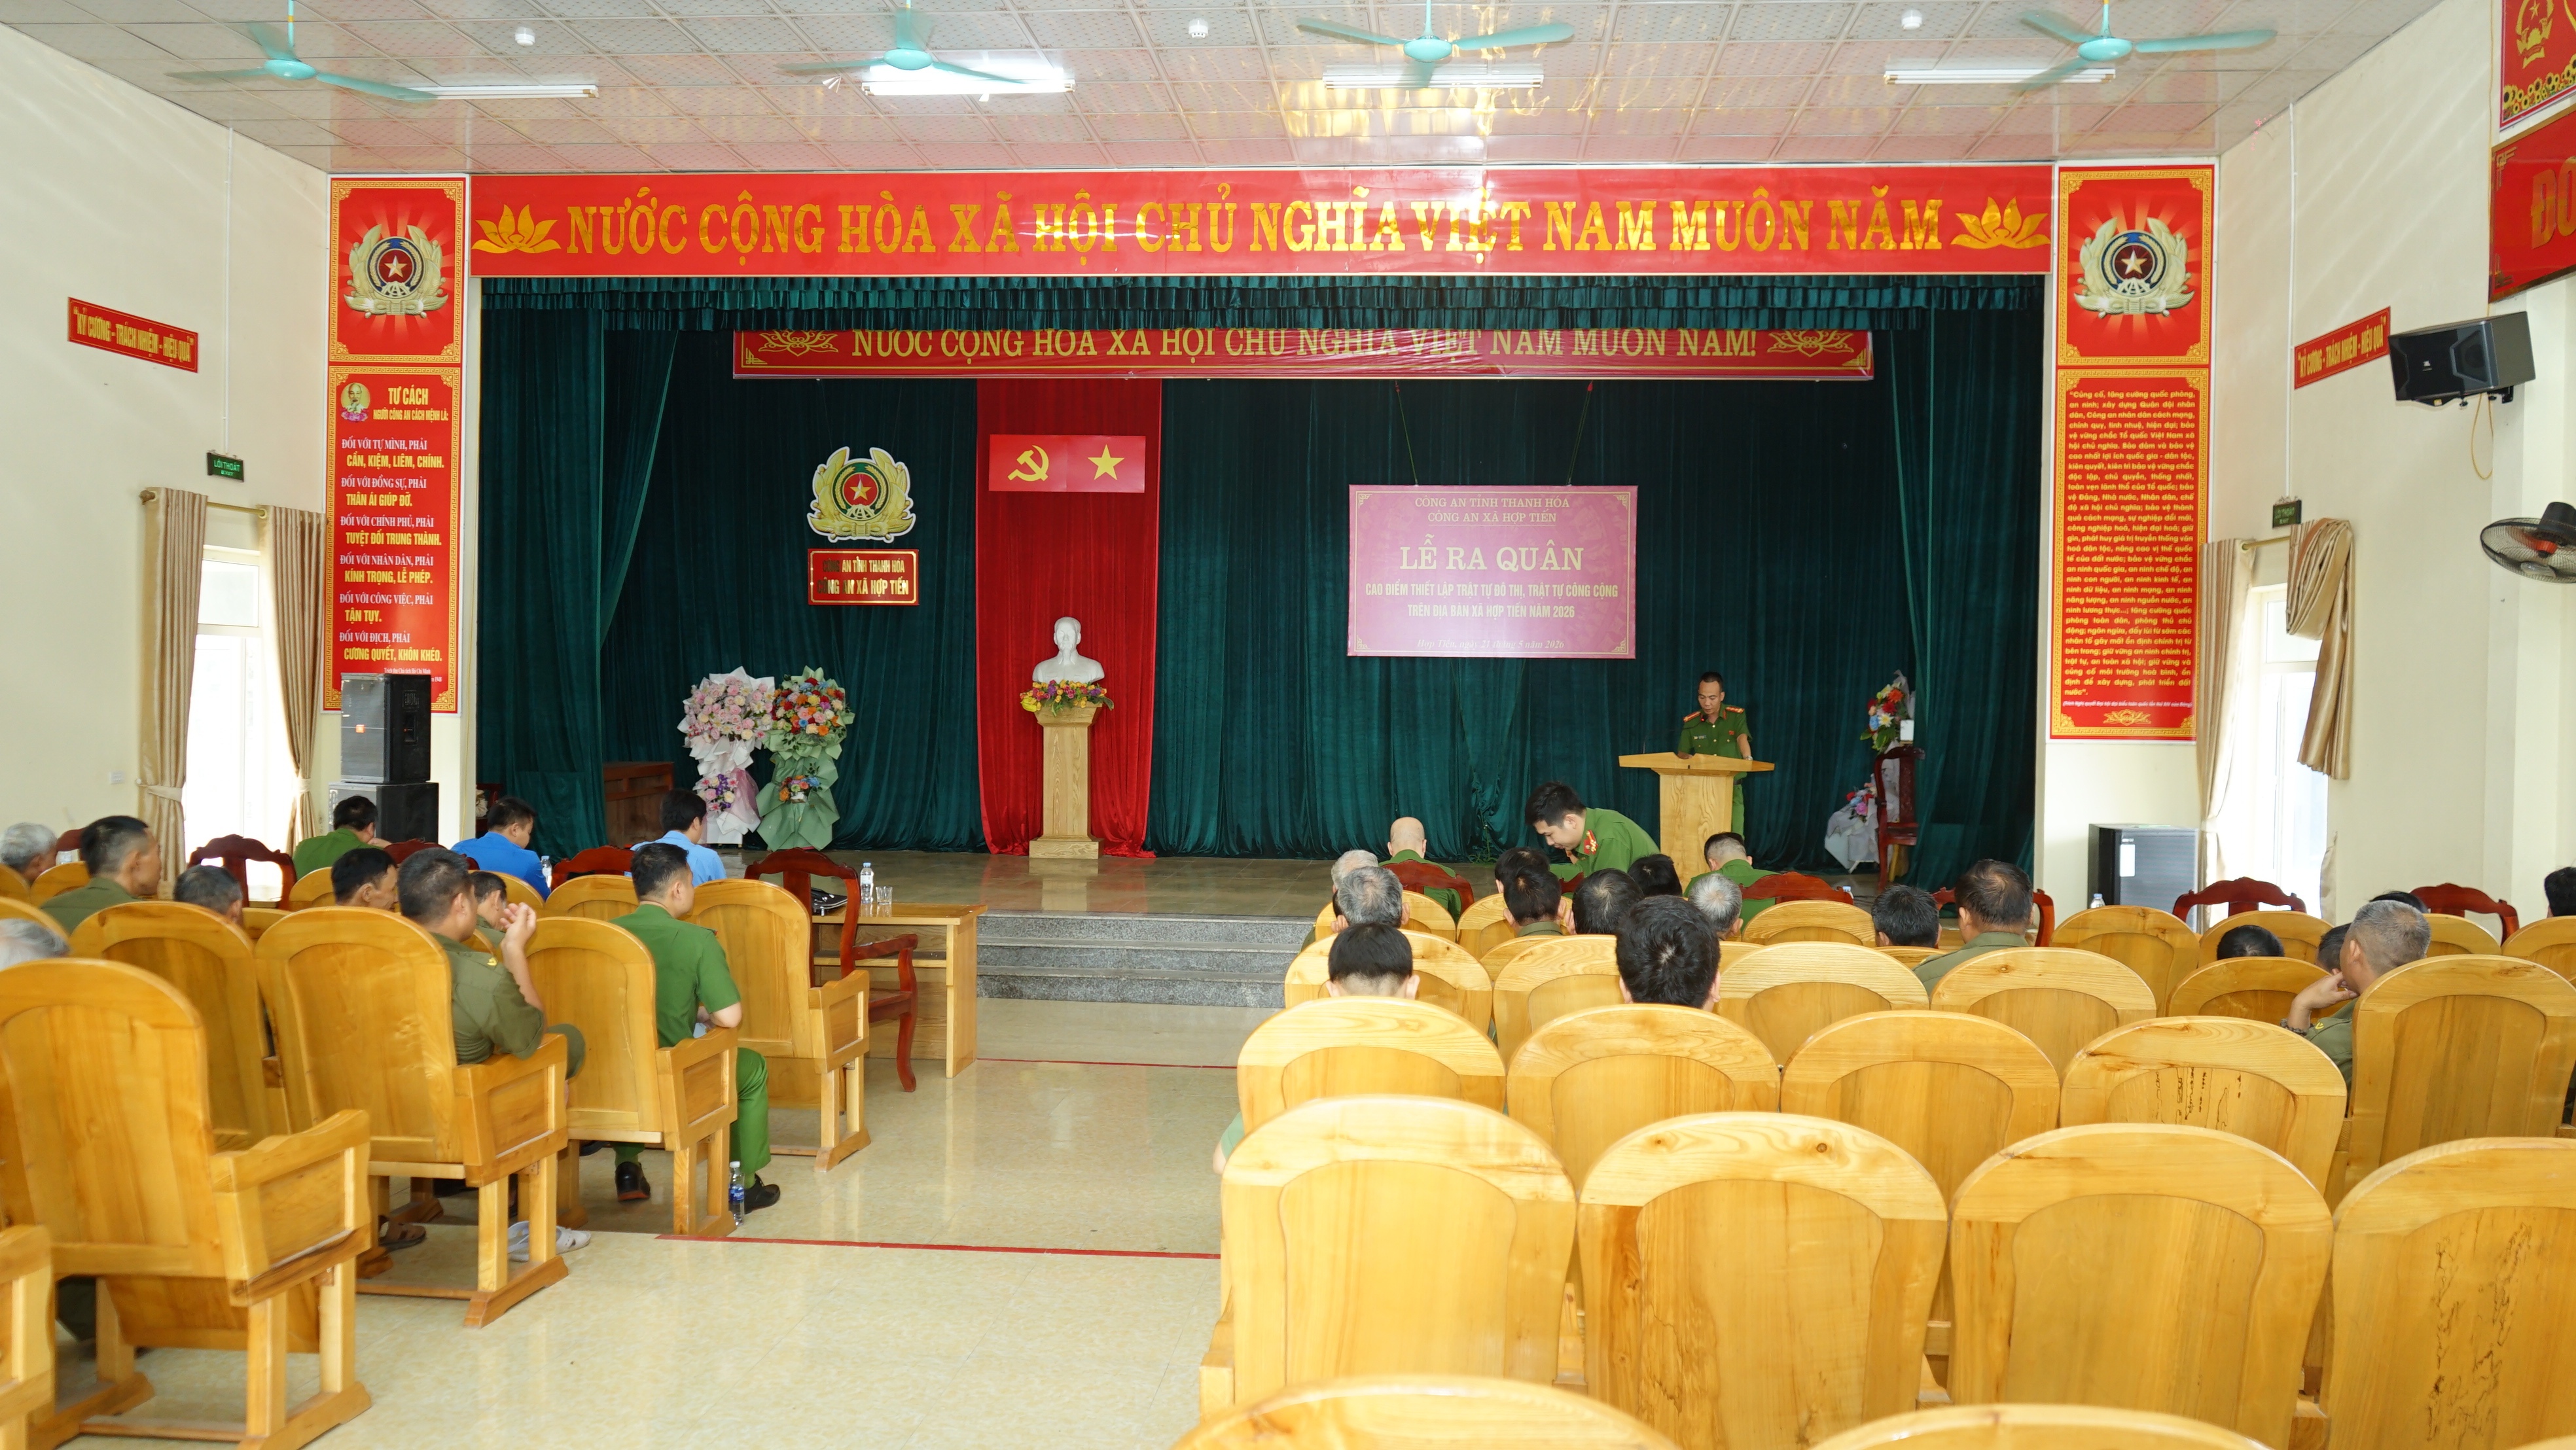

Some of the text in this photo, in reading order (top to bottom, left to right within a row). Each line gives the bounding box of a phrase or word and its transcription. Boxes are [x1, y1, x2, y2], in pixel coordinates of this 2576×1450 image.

[567, 183, 1942, 266] NƯỚC CỘNG HÒA XÃ HỘI CHỦ NGHĨA VIỆT NAM MUÔN NĂM
[1490, 329, 1564, 355] NAM
[388, 385, 429, 405] TƯ CÁCH
[342, 436, 427, 451] ĐỐI VỚI TỰ MÌNH, PHẢI
[347, 451, 444, 469] CẦN, KIỆM, LIÊM, CHÍNH.
[342, 474, 426, 490] ĐỐI VỚI ĐỒNG SỰ, PHẢI
[346, 491, 412, 506] THÂN ÁI GIÚP ĐỠ.
[1416, 495, 1447, 507] CÔNG
[1469, 495, 1498, 507] TỈNH
[1501, 499, 1542, 507] THANH
[1545, 496, 1569, 508] HÓA
[340, 513, 434, 528] ĐỐI VỚI CHÍNH PHỦ, PHẢI
[1428, 510, 1459, 522] CÔNG
[1463, 513, 1479, 522] AN
[1503, 512, 1526, 524] HỢP
[1529, 508, 1556, 522] TIẾN
[346, 529, 442, 546] TUYỆT ĐỐI TRUNG THÀNH.
[340, 552, 433, 567] ĐỐI VỚI NHÂN DÂN, PHẢI
[1399, 534, 1584, 572] LỄ RA QUÂN
[842, 559, 851, 572] AN
[869, 560, 890, 573] THANH
[891, 557, 904, 573] HÓA
[345, 567, 433, 585] KÍNH TRỌNG, LỄ PHÉP.
[817, 576, 908, 597] CÔNG AN XÃ HỢP TIẾN
[1366, 578, 1618, 599] CAO ĐIỂM THIẾT LẬP TRẬT TỰ ĐÔ THỊ, TRẬT TỰ CÔNG CỘNG
[340, 590, 433, 606] ĐỐI VỚI CÔNG VIỆC, PHẢI
[345, 607, 382, 624] TẬN TỤY.
[1408, 601, 1575, 620] TRÊN ĐỊA BÀN XÃ HỢP TIẾN NĂM 2026
[340, 629, 410, 645] ĐỐI VỚI ĐỊCH, PHẢI
[1545, 640, 1564, 648] 2026
[344, 645, 442, 662] CƯƠNG QUYẾT, KHÔN KHÉO.
